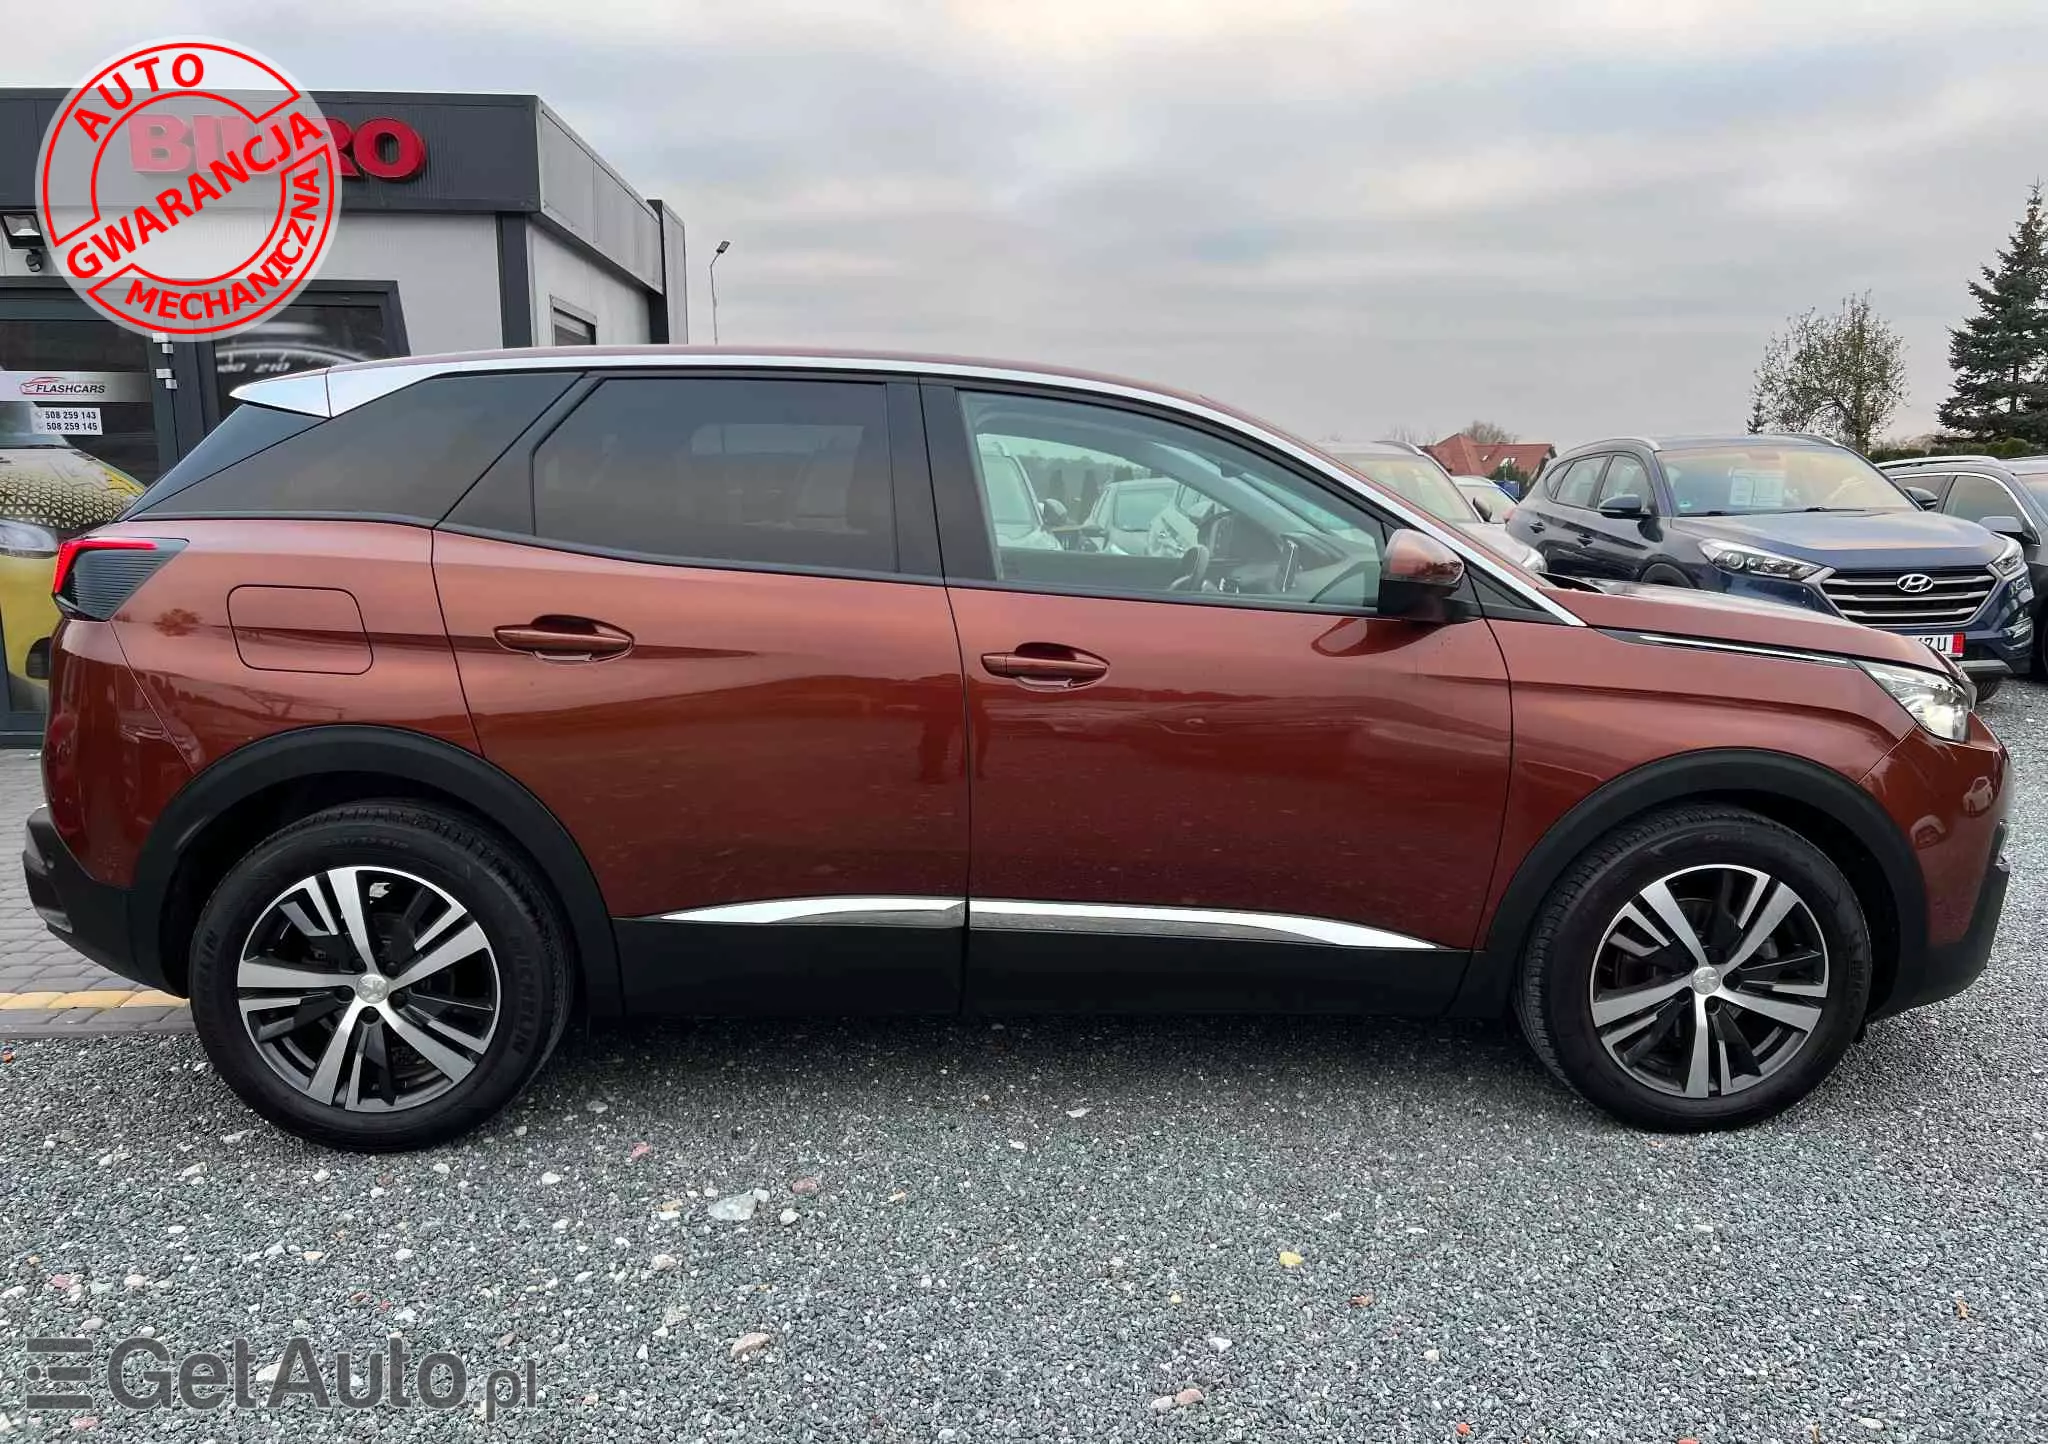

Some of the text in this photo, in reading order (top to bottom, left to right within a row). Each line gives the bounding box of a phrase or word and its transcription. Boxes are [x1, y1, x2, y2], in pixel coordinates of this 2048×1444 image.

[35, 384, 106, 394] FLASHCARS
[45, 411, 97, 420] 508 259 143
[46, 422, 98, 431] 508 259 145
